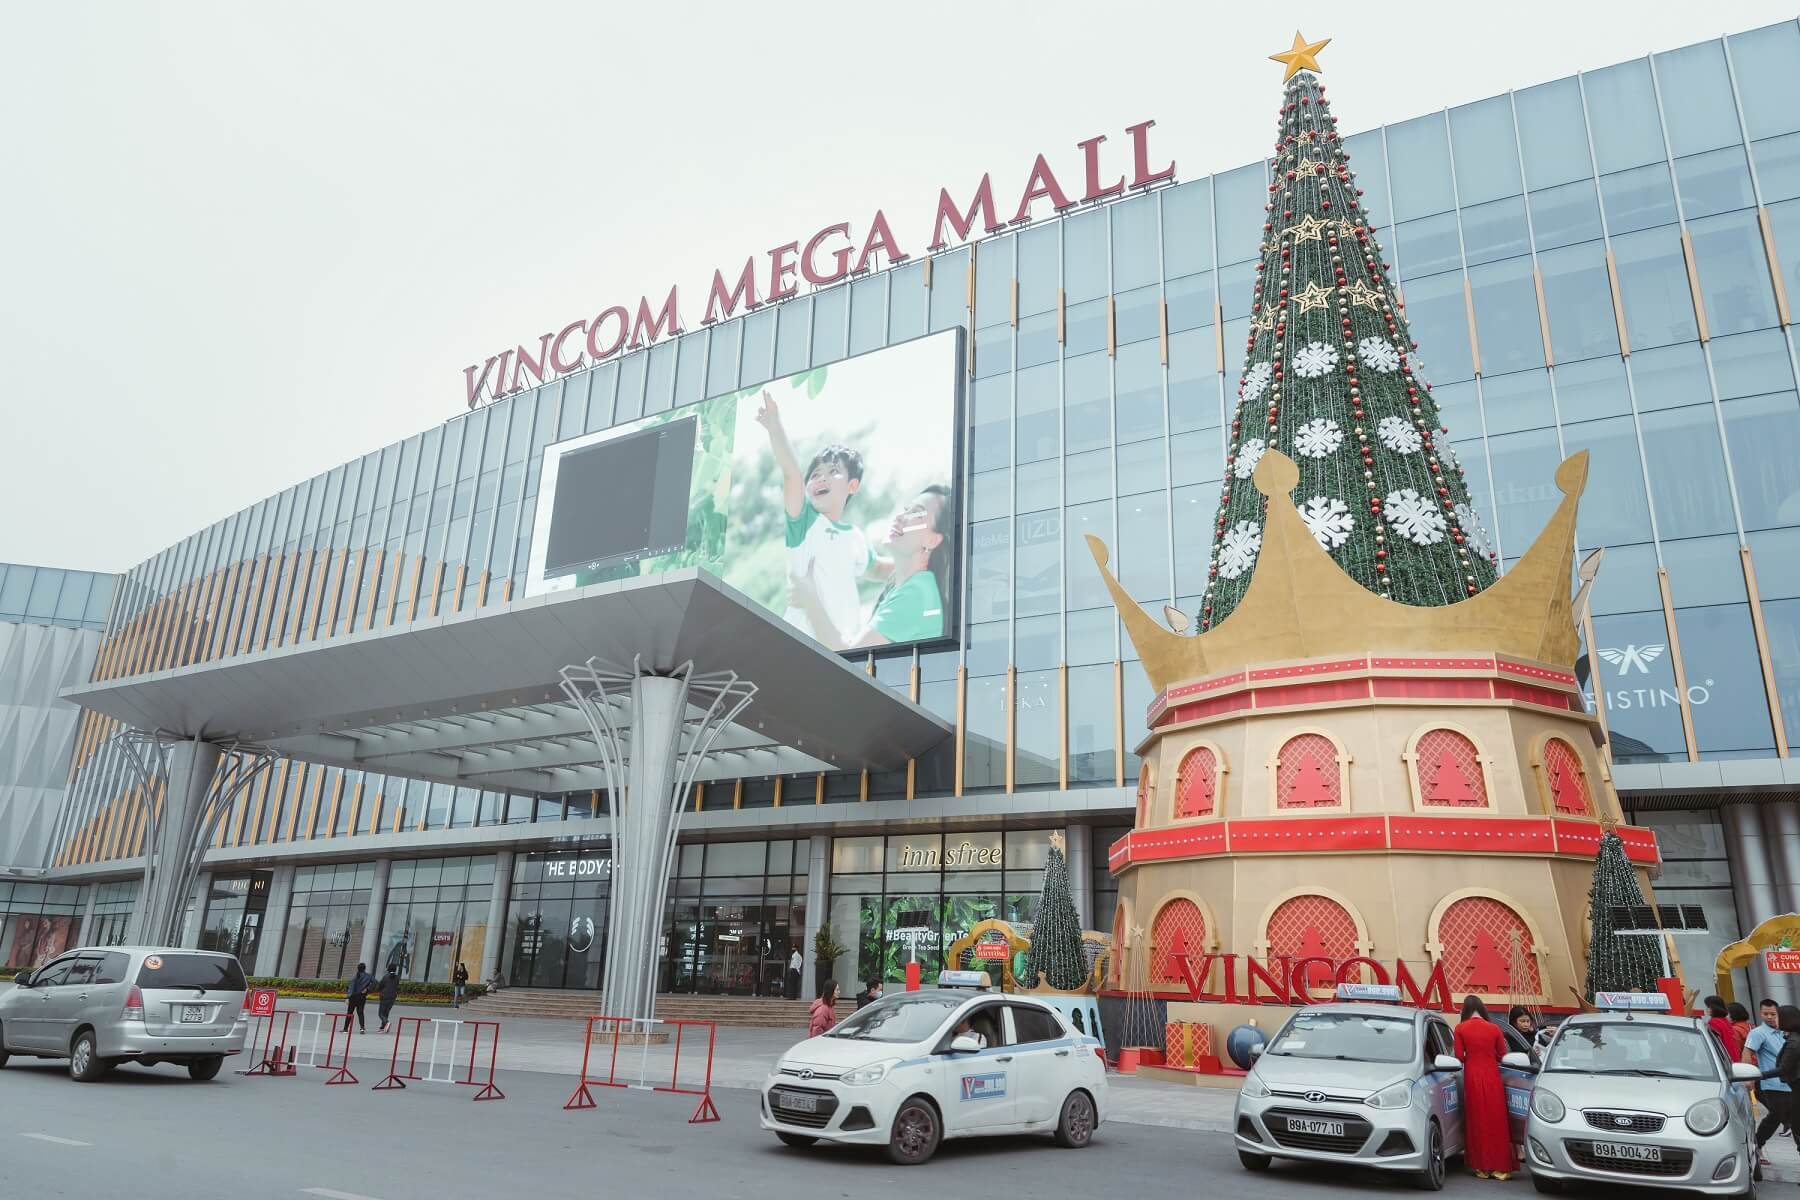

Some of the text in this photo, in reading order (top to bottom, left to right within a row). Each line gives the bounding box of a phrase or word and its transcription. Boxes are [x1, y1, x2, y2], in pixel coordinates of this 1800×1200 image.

[462, 119, 1176, 410] VINCOM MEGA MALL
[1584, 685, 1710, 712] RISTINO
[903, 841, 1002, 866] innsfree
[546, 861, 566, 877] HE
[569, 859, 605, 876] BODY
[1168, 952, 1460, 1013] VINCOM
[1289, 1119, 1342, 1135] 89A-077.10
[1595, 1143, 1659, 1160] 89A-004.28
